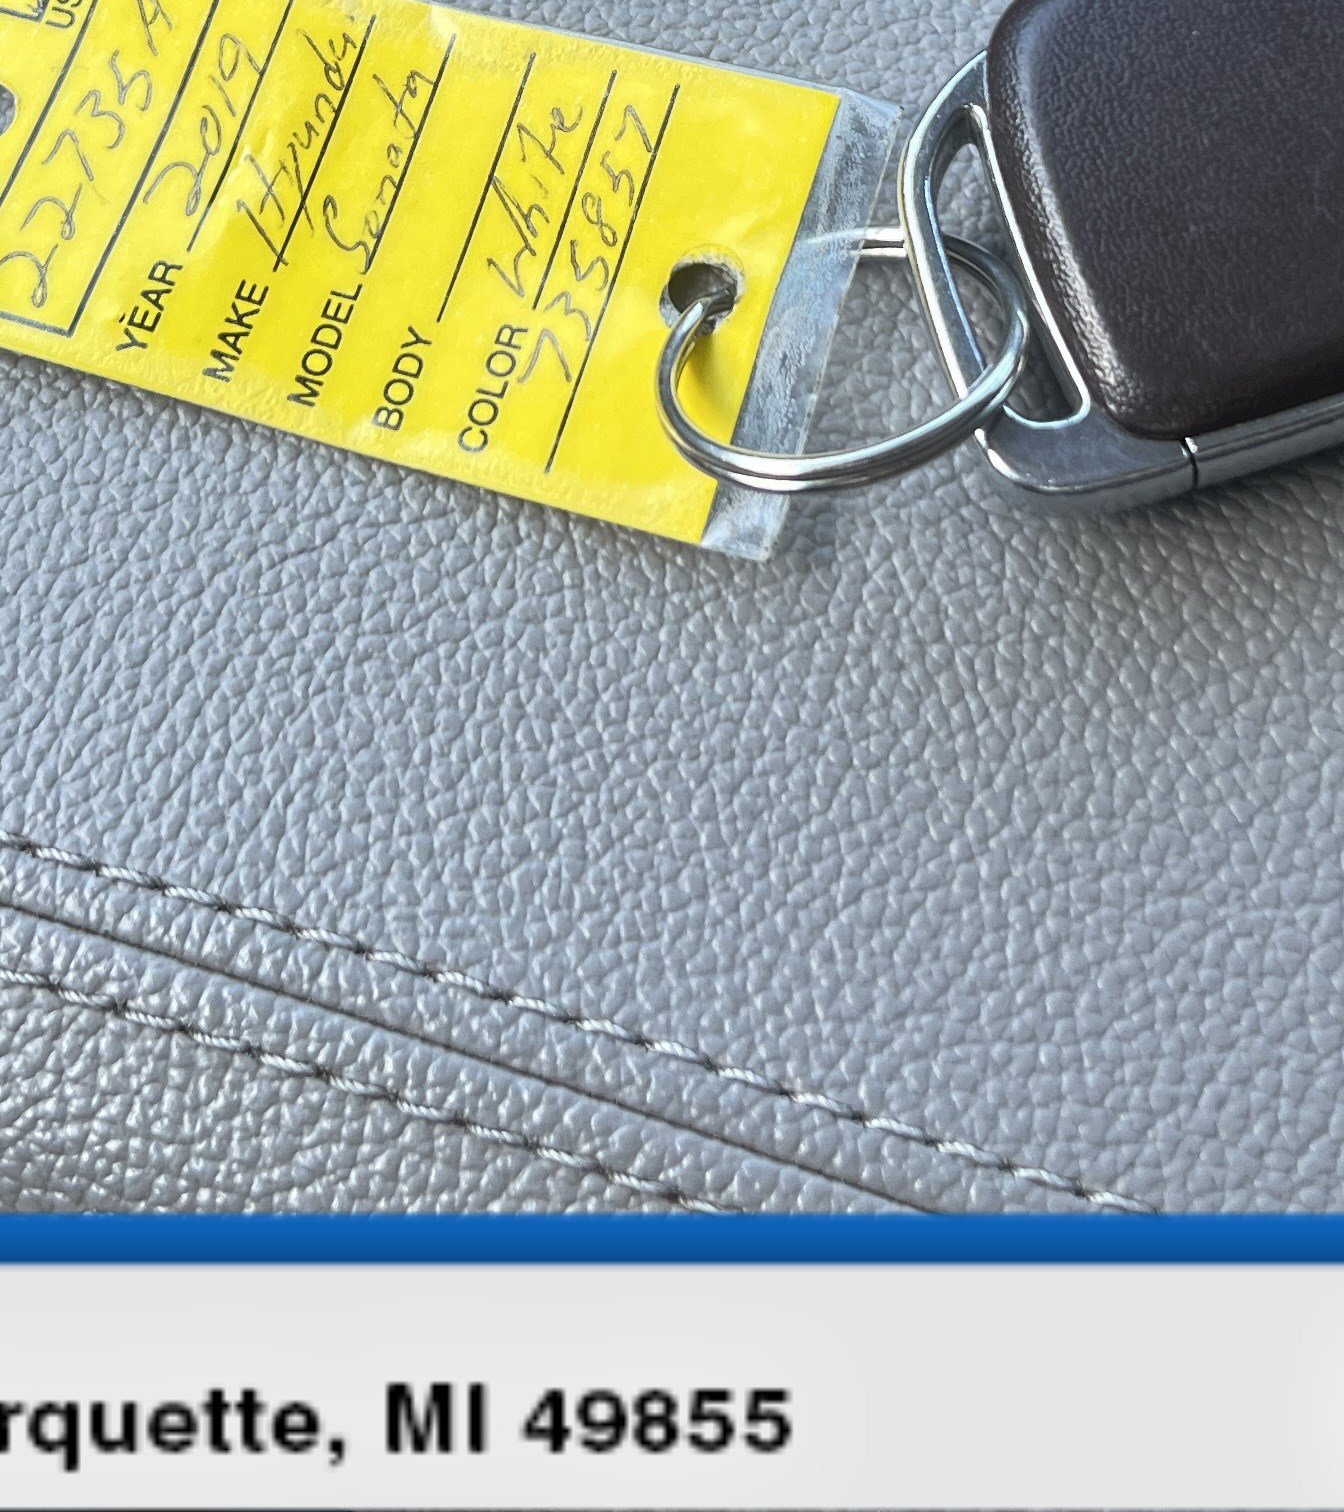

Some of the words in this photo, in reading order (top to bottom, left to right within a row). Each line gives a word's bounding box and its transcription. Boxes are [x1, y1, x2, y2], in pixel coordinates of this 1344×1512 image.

[143, 33, 264, 217] 2019
[322, 69, 437, 275] Sonata
[116, 260, 183, 352] YEAR
[516, 104, 653, 383] 735857
[202, 279, 270, 383] MAKE
[286, 283, 364, 408] MODEL
[370, 325, 433, 432] BODY
[457, 323, 529, 454] COLOR
